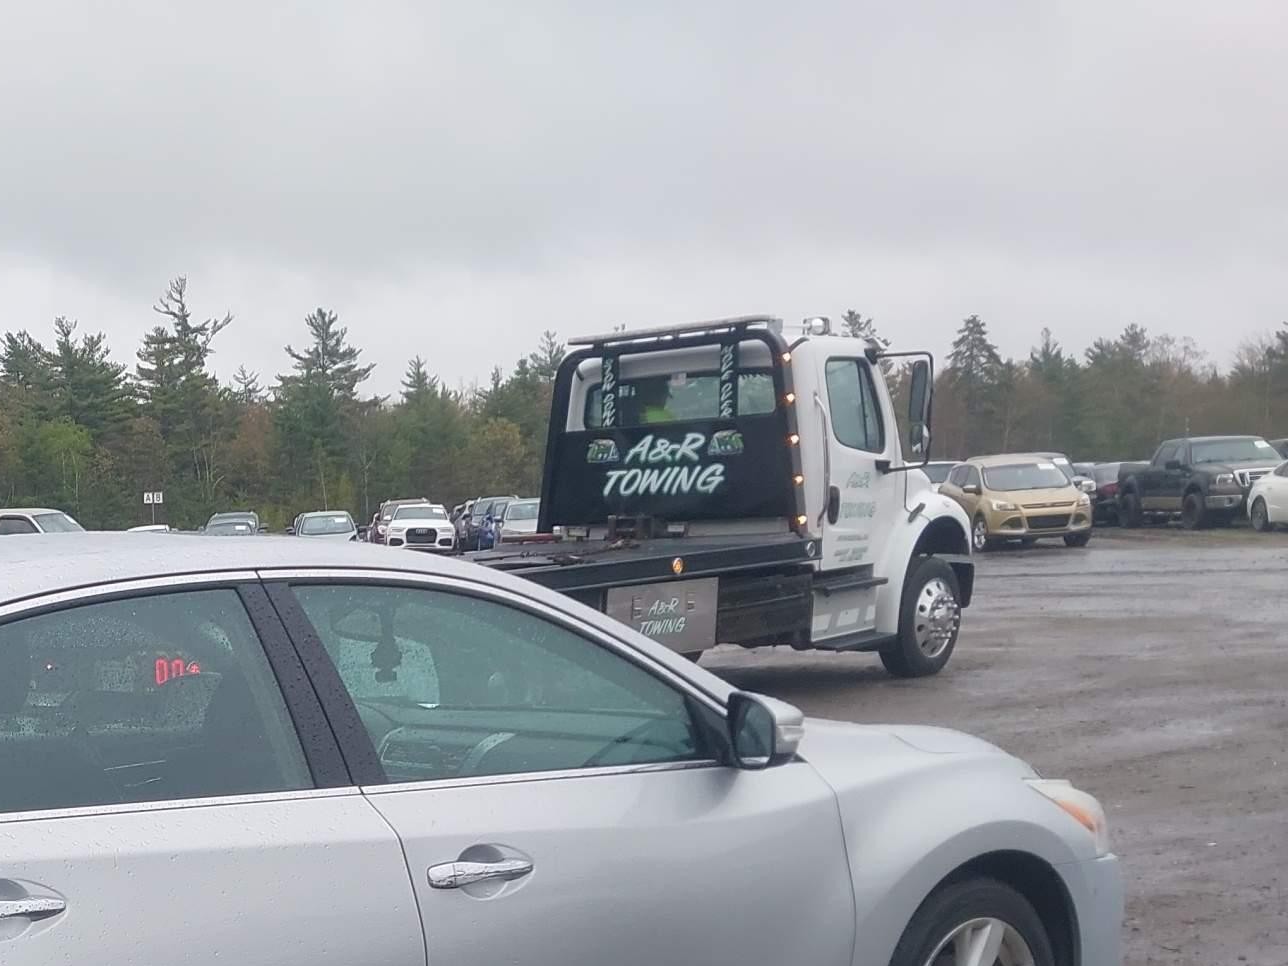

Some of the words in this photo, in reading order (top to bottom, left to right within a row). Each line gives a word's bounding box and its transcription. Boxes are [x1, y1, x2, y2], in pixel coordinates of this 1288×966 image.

[602, 359, 616, 391] SLOW
[721, 344, 734, 380] MOVE
[603, 393, 616, 427] DOWN
[721, 383, 733, 418] OVER
[624, 432, 705, 464] A&R
[603, 463, 725, 497] TOWING
[647, 597, 679, 616] A&R
[639, 616, 686, 636] TOWING
